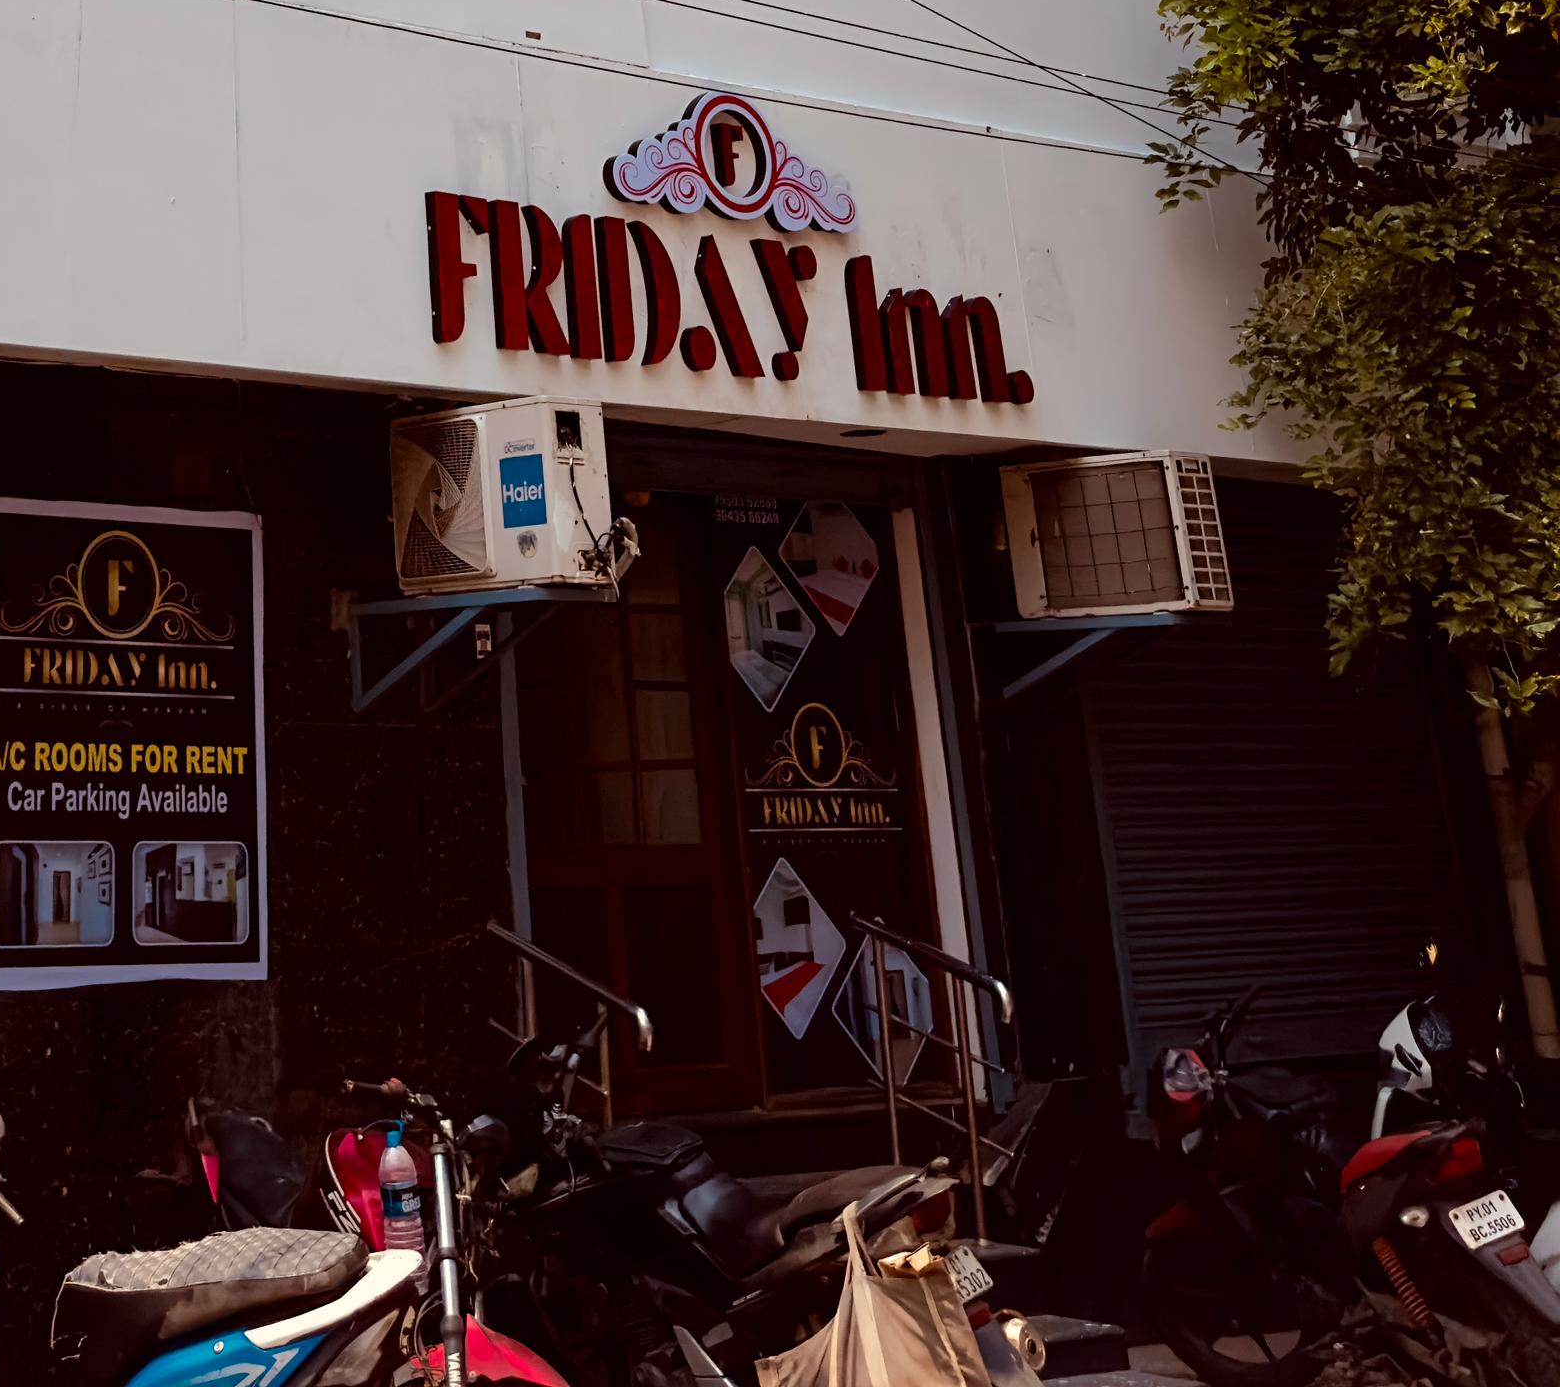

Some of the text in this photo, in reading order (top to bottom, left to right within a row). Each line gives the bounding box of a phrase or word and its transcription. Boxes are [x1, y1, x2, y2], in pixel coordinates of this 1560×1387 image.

[425, 191, 817, 381] FRIDAY
[502, 480, 543, 503] Haier
[23, 647, 147, 687] FRIDAY
[34, 742, 123, 773] ROOMS
[131, 744, 178, 774] FOR
[186, 745, 248, 775] RENT
[7, 781, 229, 820] Car Parking Available
[763, 796, 843, 825] FRIDAY
[1466, 1200, 1498, 1222] PY.01
[1469, 1214, 1517, 1241] BC.5506
